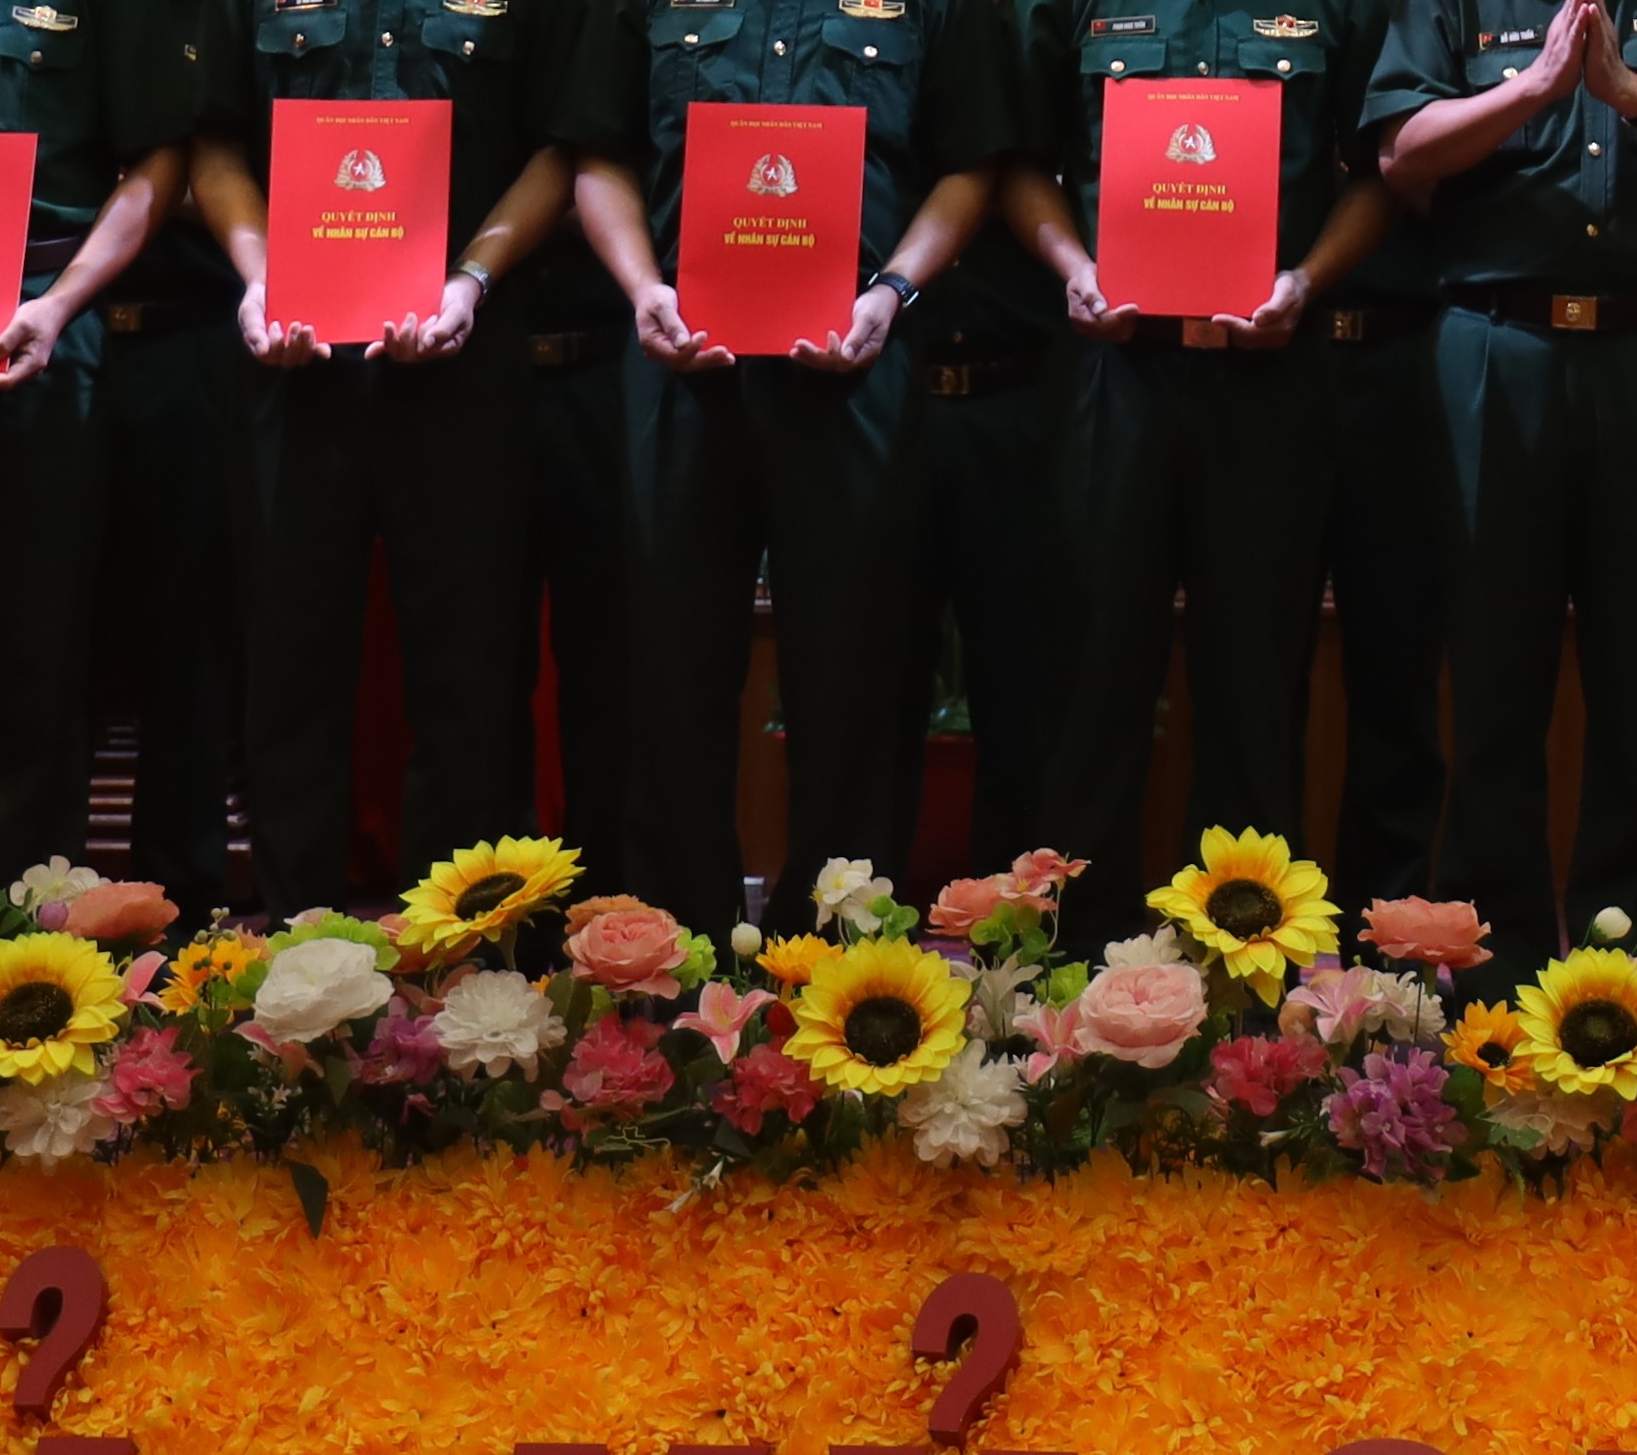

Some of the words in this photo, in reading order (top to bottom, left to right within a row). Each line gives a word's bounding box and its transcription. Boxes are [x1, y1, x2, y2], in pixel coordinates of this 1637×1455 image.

[1153, 182, 1194, 194] QUYẾT
[1197, 185, 1226, 195] ĐỊNH
[1158, 198, 1184, 209] NHÂN
[1200, 200, 1220, 210] CÁN
[1221, 200, 1234, 213] BỘ
[322, 211, 364, 223] QUYẾT
[366, 212, 396, 223] ĐỊNH
[733, 217, 774, 228] QUYẾT
[777, 219, 806, 229] ĐỊNH
[326, 227, 353, 238] NHÂN
[370, 227, 390, 238] CÁN
[391, 226, 404, 239] BỘ
[738, 233, 764, 244] NHÂN
[780, 234, 800, 245] CÁN
[802, 234, 814, 247] BỘ
